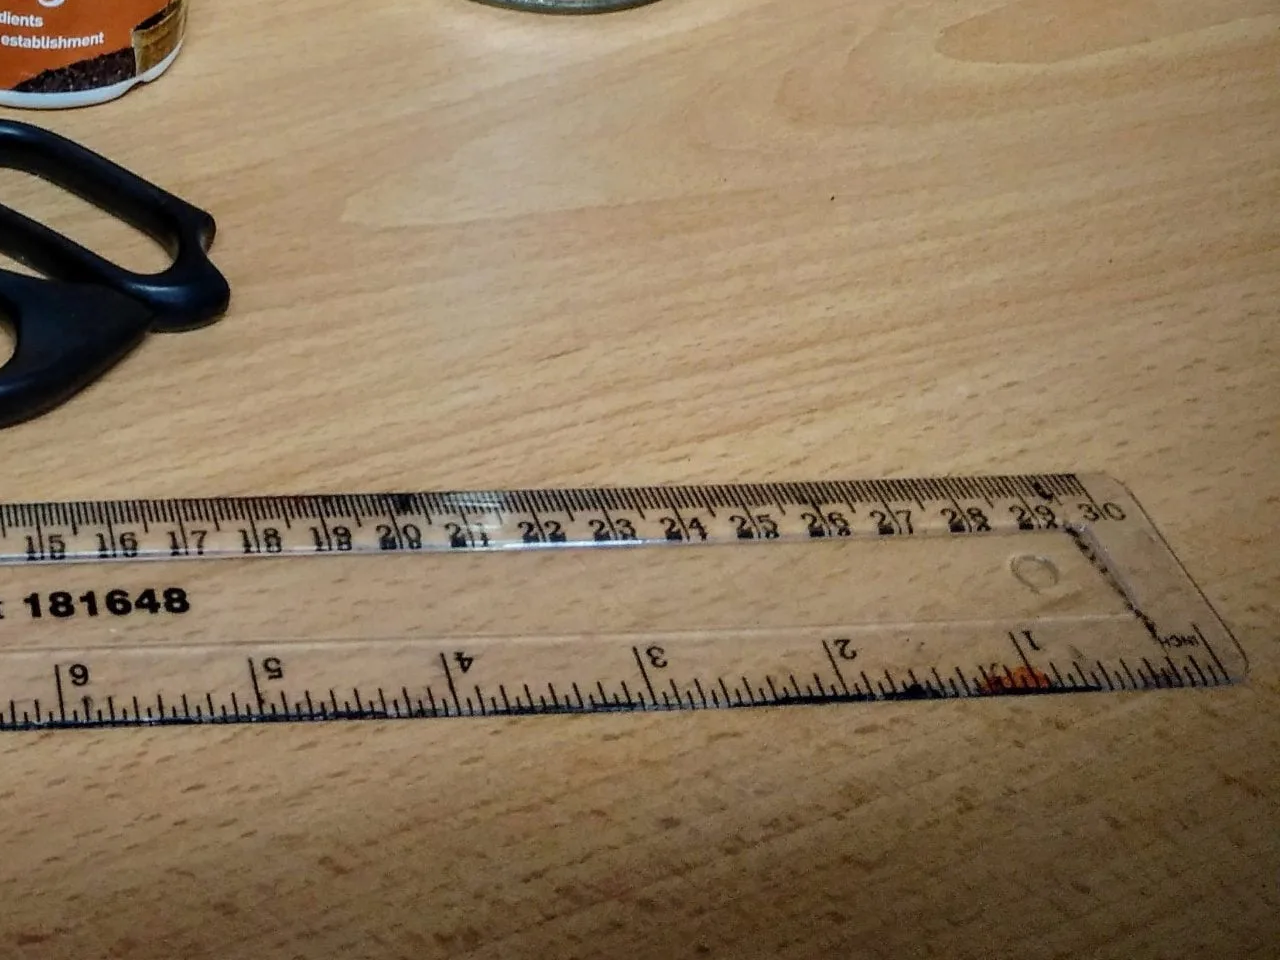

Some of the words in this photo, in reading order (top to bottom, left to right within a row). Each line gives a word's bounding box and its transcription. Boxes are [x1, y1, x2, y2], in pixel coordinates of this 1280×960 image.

[1, 32, 105, 50] establishment
[24, 534, 66, 561] 15
[96, 531, 138, 559] 16
[166, 529, 208, 556] 17
[238, 527, 282, 553] 18
[309, 525, 352, 552] 19
[376, 523, 422, 550] 20
[518, 520, 566, 542] 22
[588, 518, 637, 541] 23
[659, 516, 707, 540] 24
[729, 514, 779, 539] 25
[801, 511, 851, 537] 26
[870, 509, 913, 535] 27
[940, 507, 991, 532] 28
[1008, 504, 1058, 530] 29
[1077, 501, 1126, 521] 30
[24, 588, 191, 619] 181648
